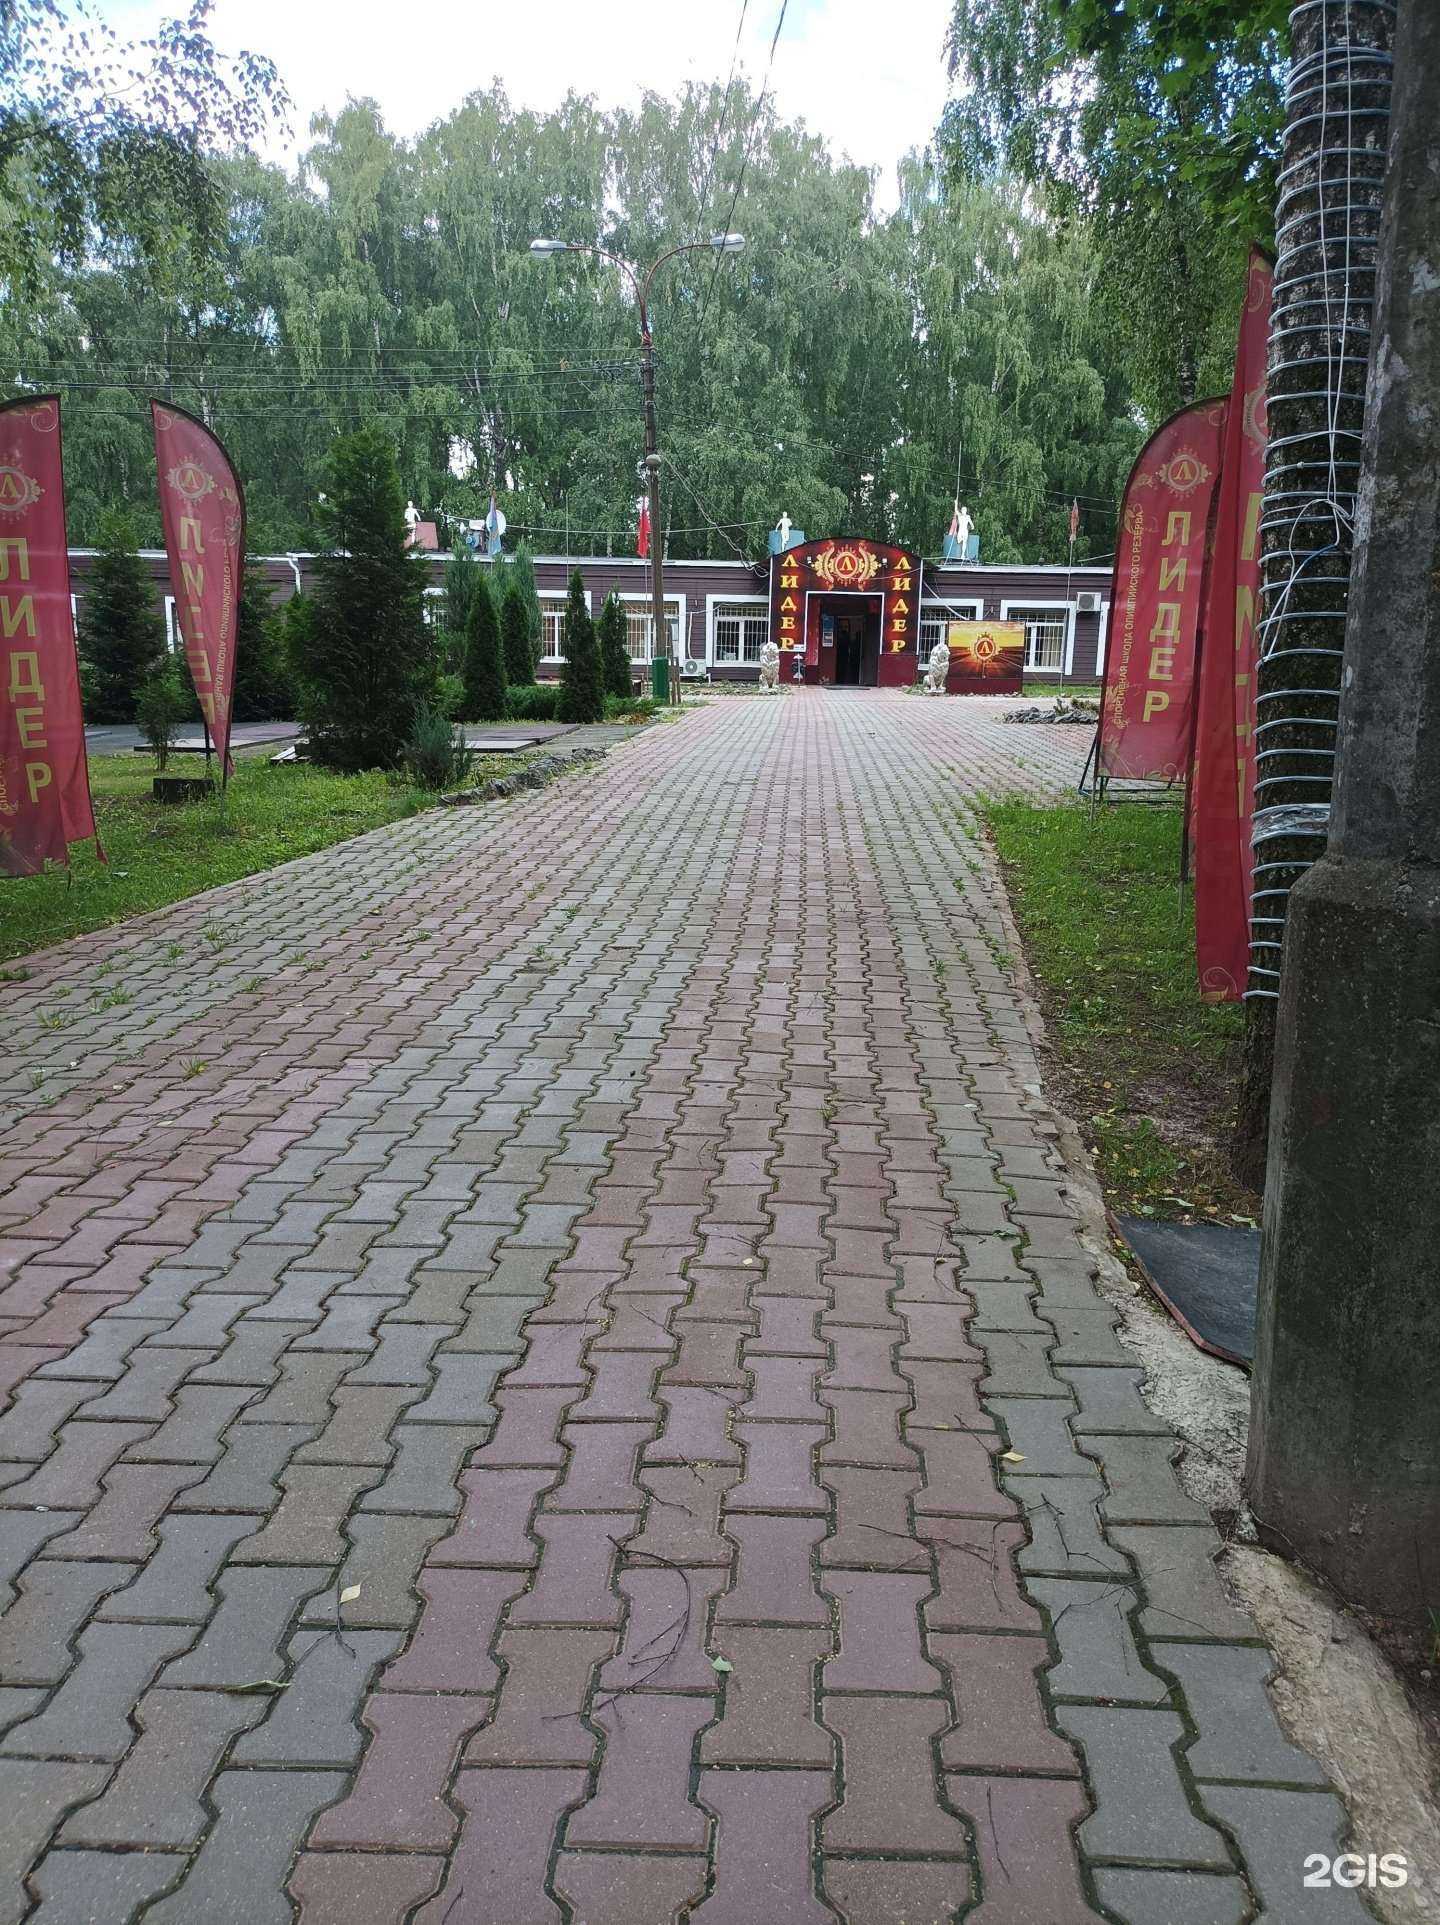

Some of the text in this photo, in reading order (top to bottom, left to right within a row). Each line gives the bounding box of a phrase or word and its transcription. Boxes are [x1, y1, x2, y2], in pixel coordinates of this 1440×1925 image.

[0, 537, 52, 803] ЛИДЕР
[780, 554, 799, 650] ЛИДЕР
[890, 556, 912, 653] ЛИДЕР
[1113, 511, 1144, 726] СПОРТИВНАЯ ШКОЛА ОЛИМПИЙСКОГО РЕЗЕРВА
[1142, 511, 1192, 723] ЛИДЕР
